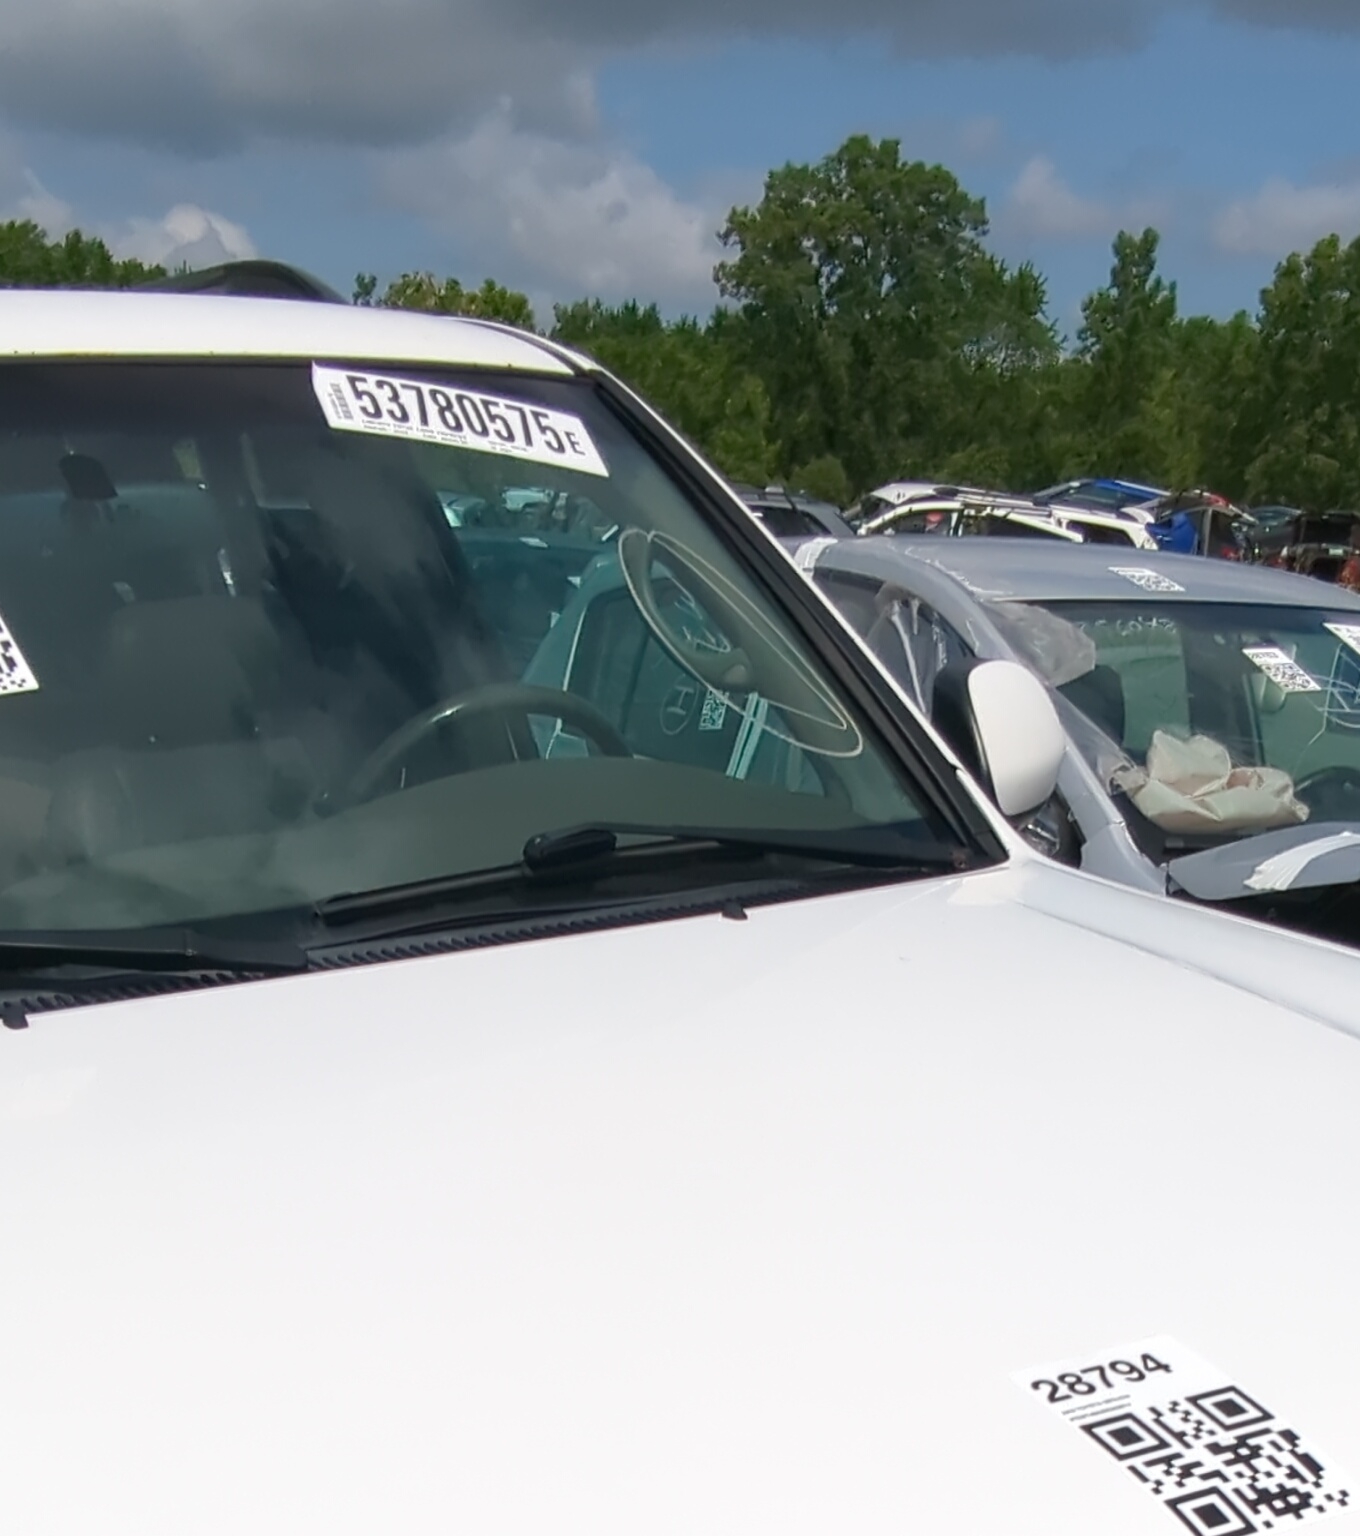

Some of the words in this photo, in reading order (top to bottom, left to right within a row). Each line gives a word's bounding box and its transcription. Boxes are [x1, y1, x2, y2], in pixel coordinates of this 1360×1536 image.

[345, 375, 565, 454] 53780575
[565, 431, 586, 455] E
[1031, 1353, 1173, 1403] 28794
